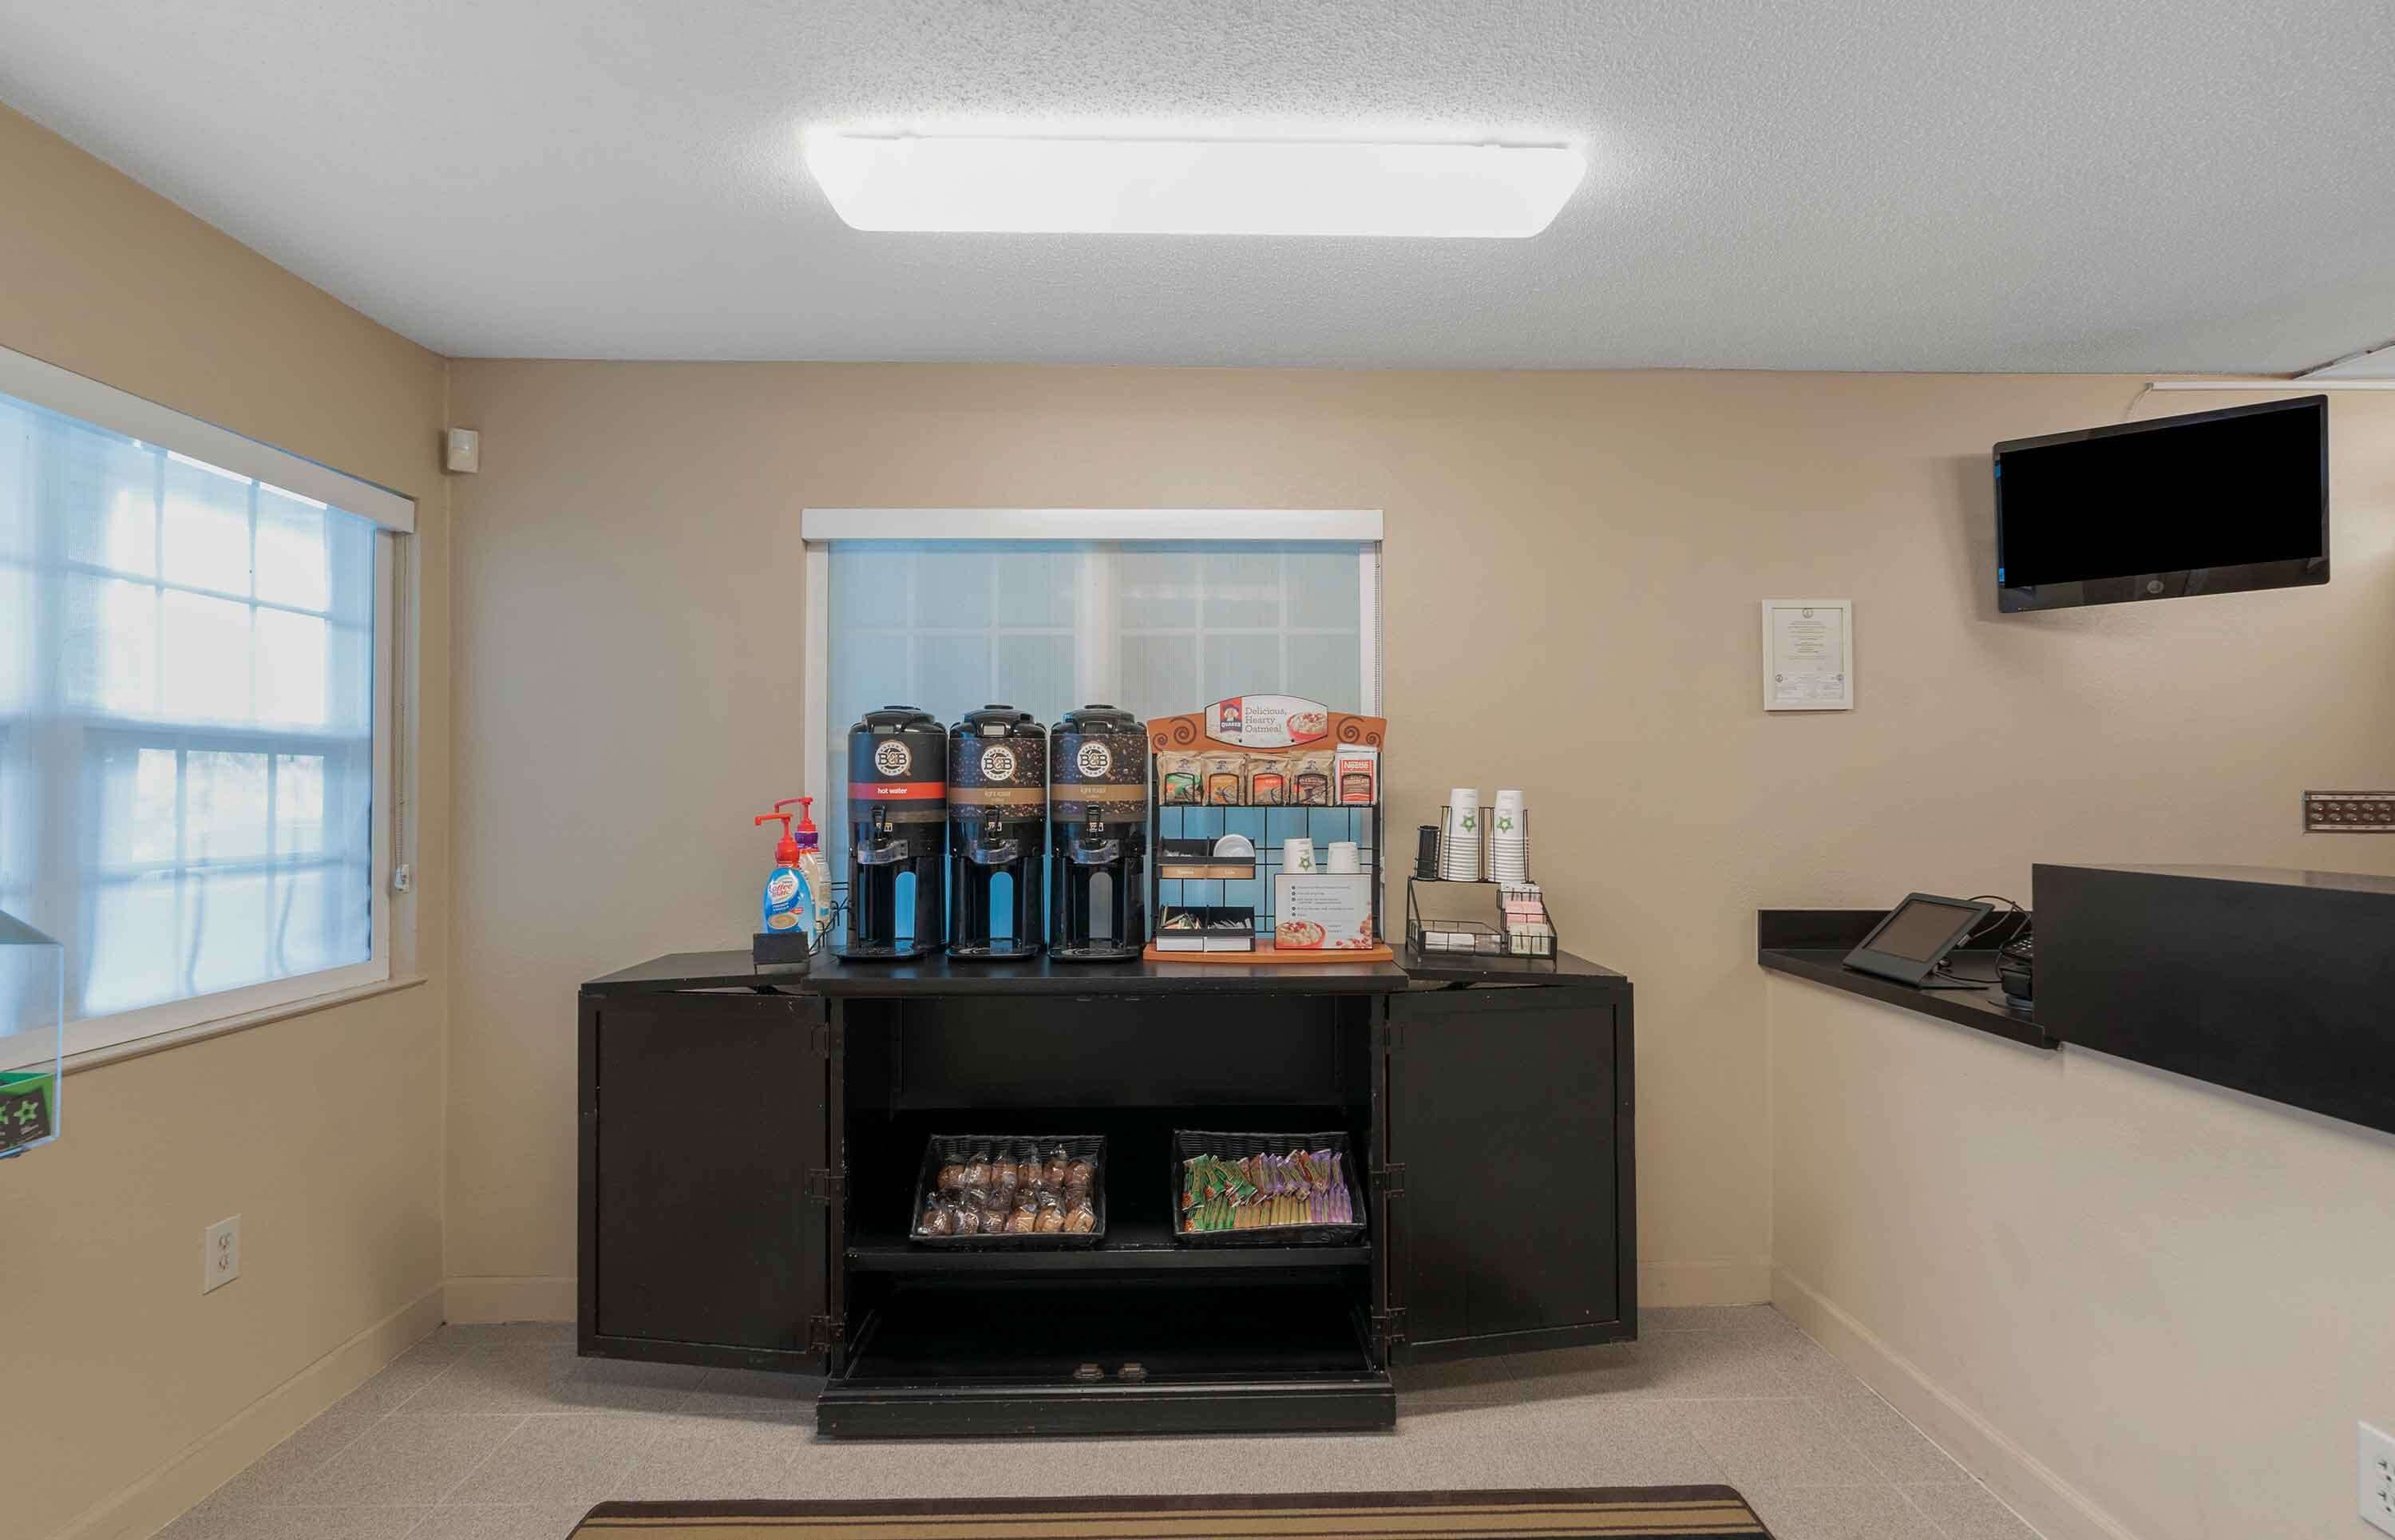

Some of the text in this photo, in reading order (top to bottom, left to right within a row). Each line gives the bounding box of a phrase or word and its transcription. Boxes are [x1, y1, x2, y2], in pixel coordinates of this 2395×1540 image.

[1245, 707, 1288, 716] Delicious,
[1245, 716, 1276, 725] Hearty
[1245, 724, 1281, 734] Oatmeal
[877, 753, 907, 766] B&B
[983, 758, 1012, 770] B&B
[1079, 754, 1108, 766] B&B
[769, 883, 793, 894] Coffee
